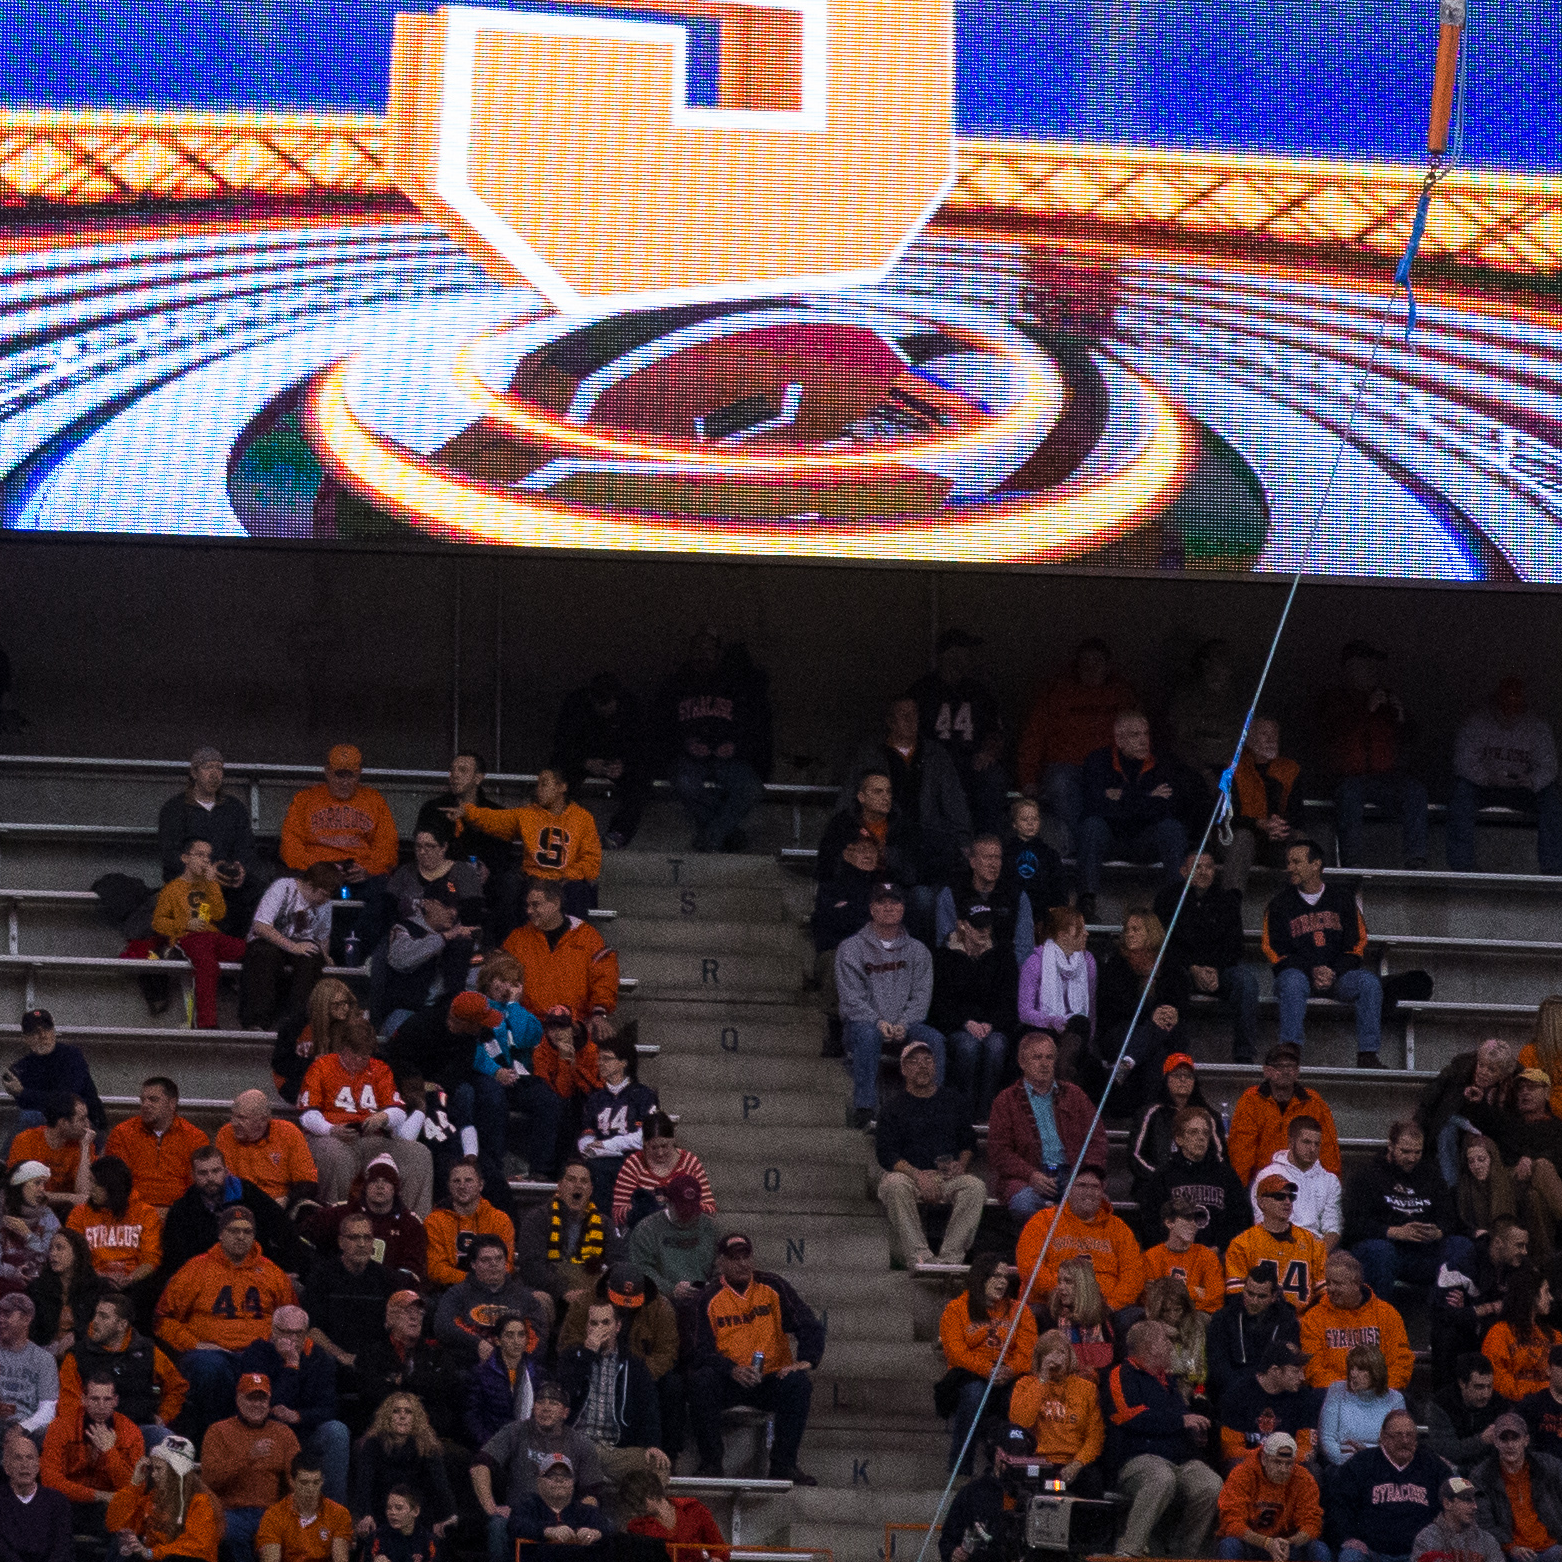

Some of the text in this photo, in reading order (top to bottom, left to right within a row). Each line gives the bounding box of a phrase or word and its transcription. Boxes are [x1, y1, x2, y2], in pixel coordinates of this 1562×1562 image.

[935, 701, 975, 741] 44
[535, 826, 570, 870] S
[667, 857, 685, 885] T
[679, 890, 697, 916] S
[702, 958, 721, 984] R
[334, 1084, 379, 1115] 44
[742, 1094, 761, 1120] P
[597, 1104, 629, 1137] 44
[786, 1237, 806, 1264] N
[212, 1284, 265, 1320] 44
[851, 1457, 871, 1486] K
[1371, 1481, 1430, 1507] SYRACUSE
[877, 1532, 897, 1561] J
